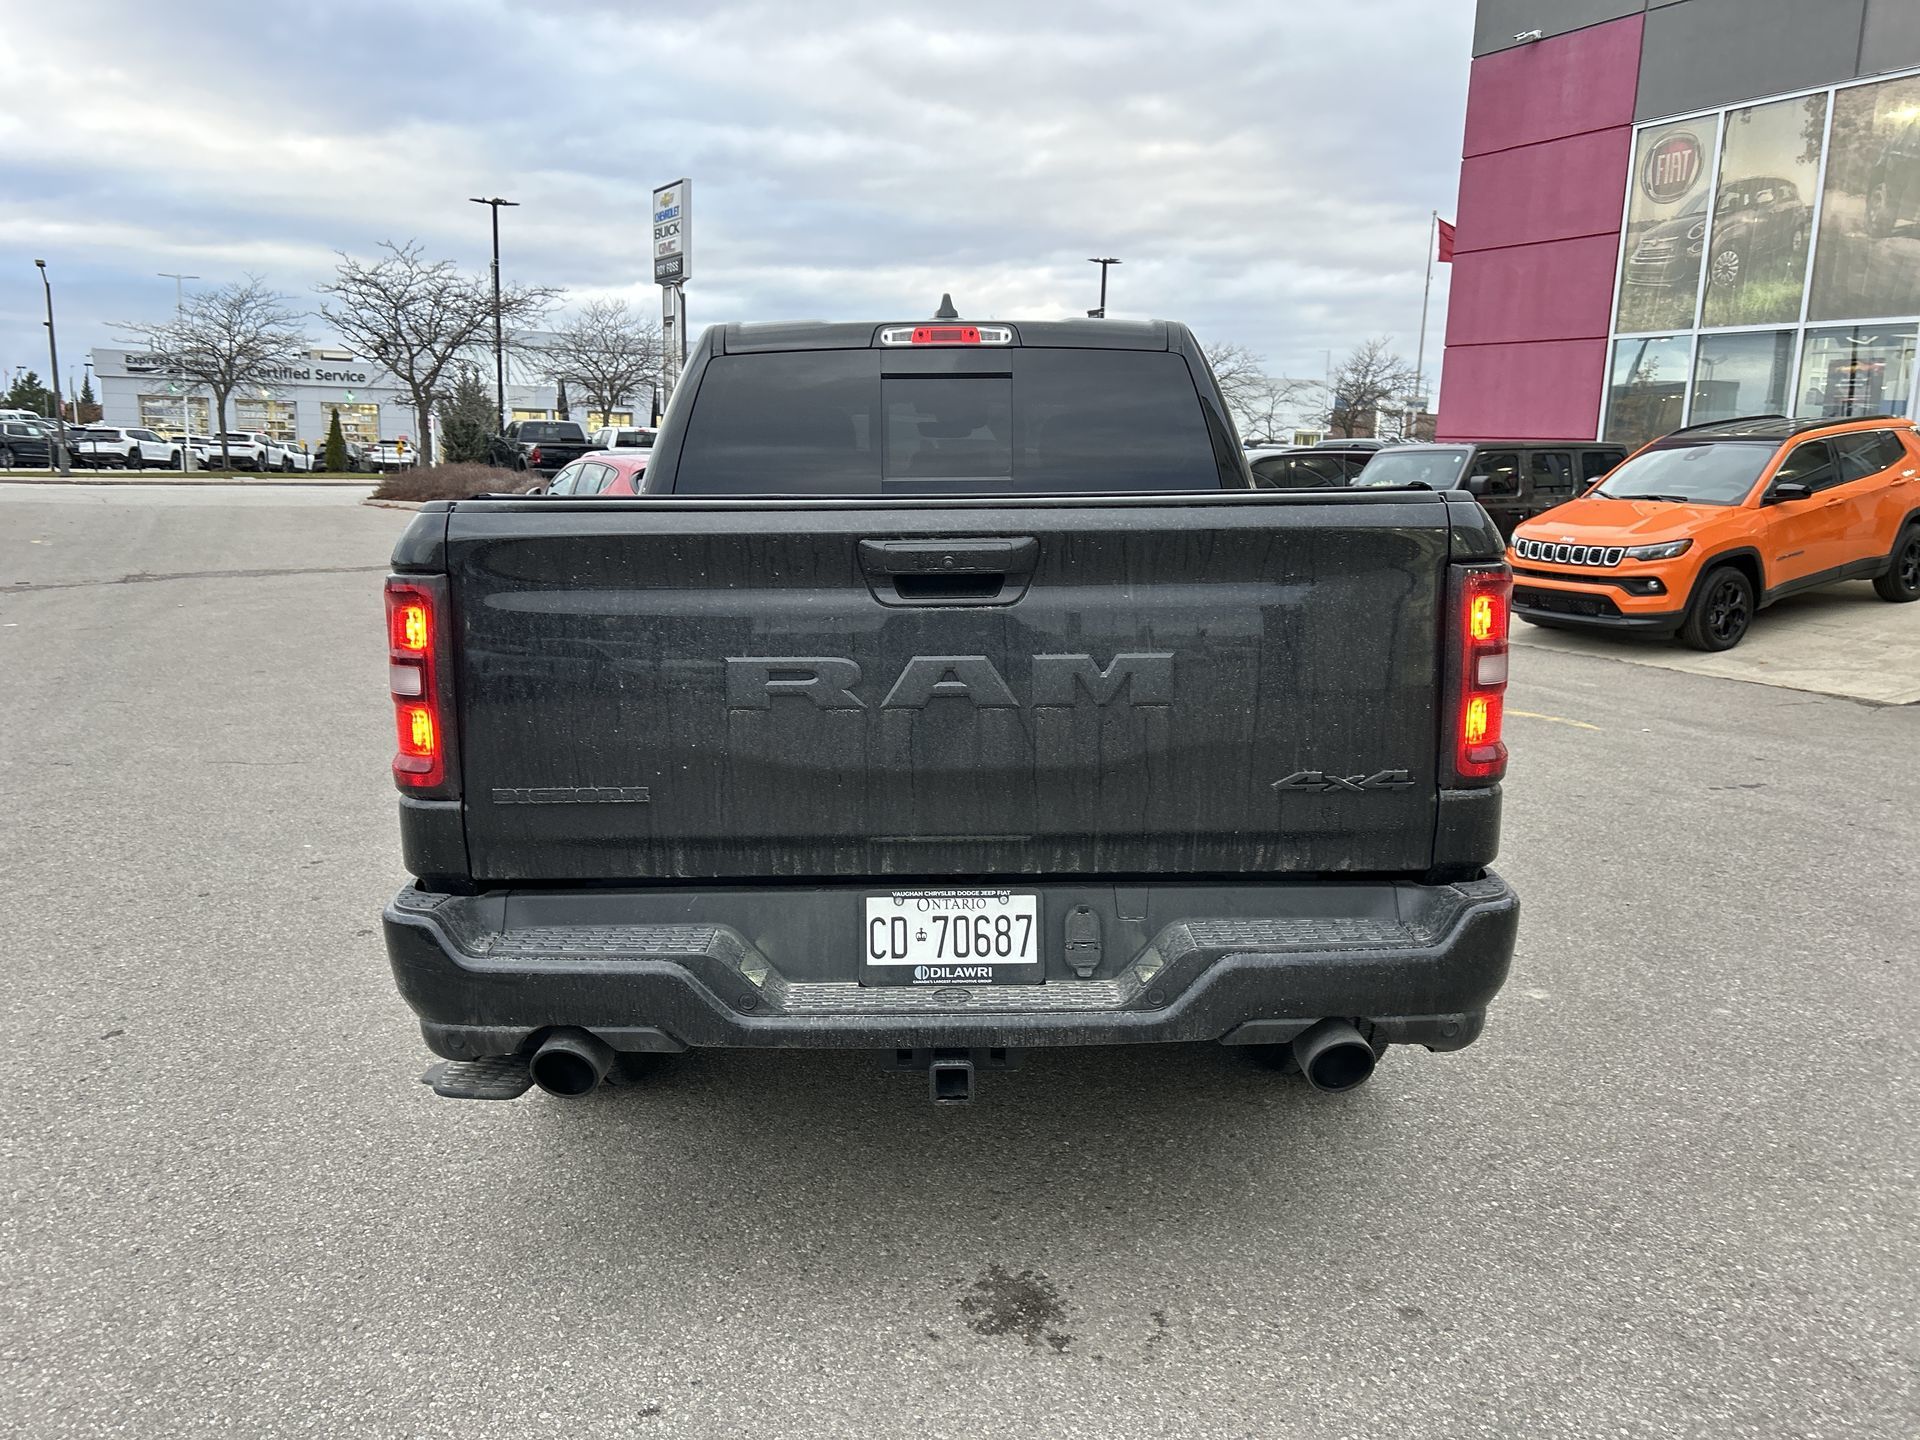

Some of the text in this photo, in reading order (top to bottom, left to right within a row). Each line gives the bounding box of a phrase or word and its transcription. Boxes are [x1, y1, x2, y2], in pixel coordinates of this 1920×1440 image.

[1655, 149, 1692, 186] FIAT
[654, 221, 680, 240] BUICK
[666, 260, 679, 274] FOSS
[247, 367, 366, 382] Certified Service
[725, 653, 1175, 710] RAM
[870, 914, 1033, 959] CD 70687
[930, 967, 993, 978] DILAWRI
